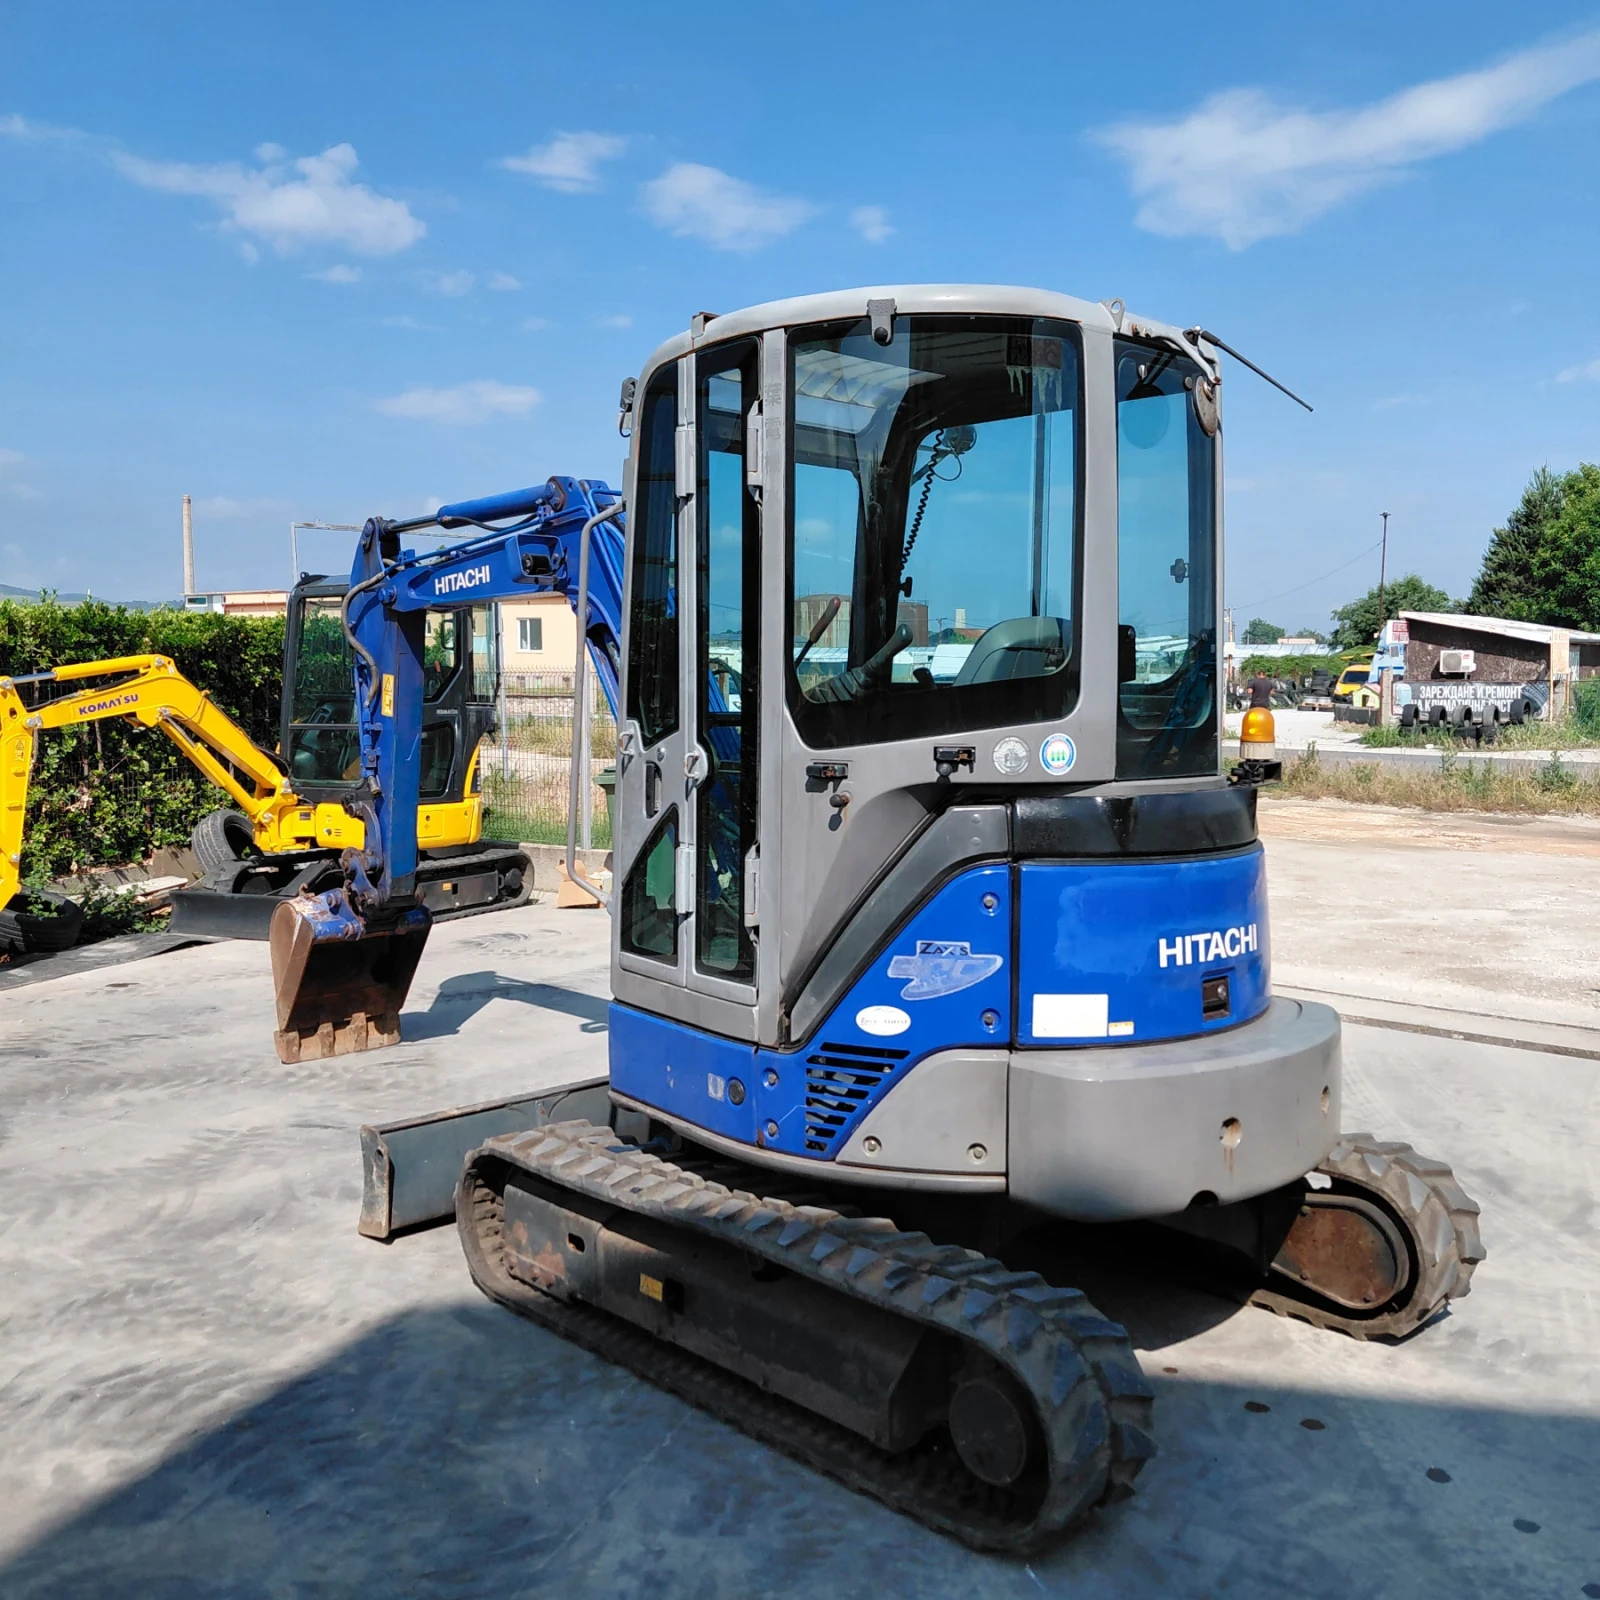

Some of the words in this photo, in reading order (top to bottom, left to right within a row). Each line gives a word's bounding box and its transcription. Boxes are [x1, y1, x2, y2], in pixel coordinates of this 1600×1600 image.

[435, 565, 490, 595] HITACHI
[1420, 685, 1475, 699] ЗАРЕЖДАНЕ
[1486, 685, 1522, 700] РЕМОНТ
[79, 694, 138, 715] KOMATSU
[919, 942, 969, 956] ZAXS
[1159, 923, 1257, 968] HITACHI
